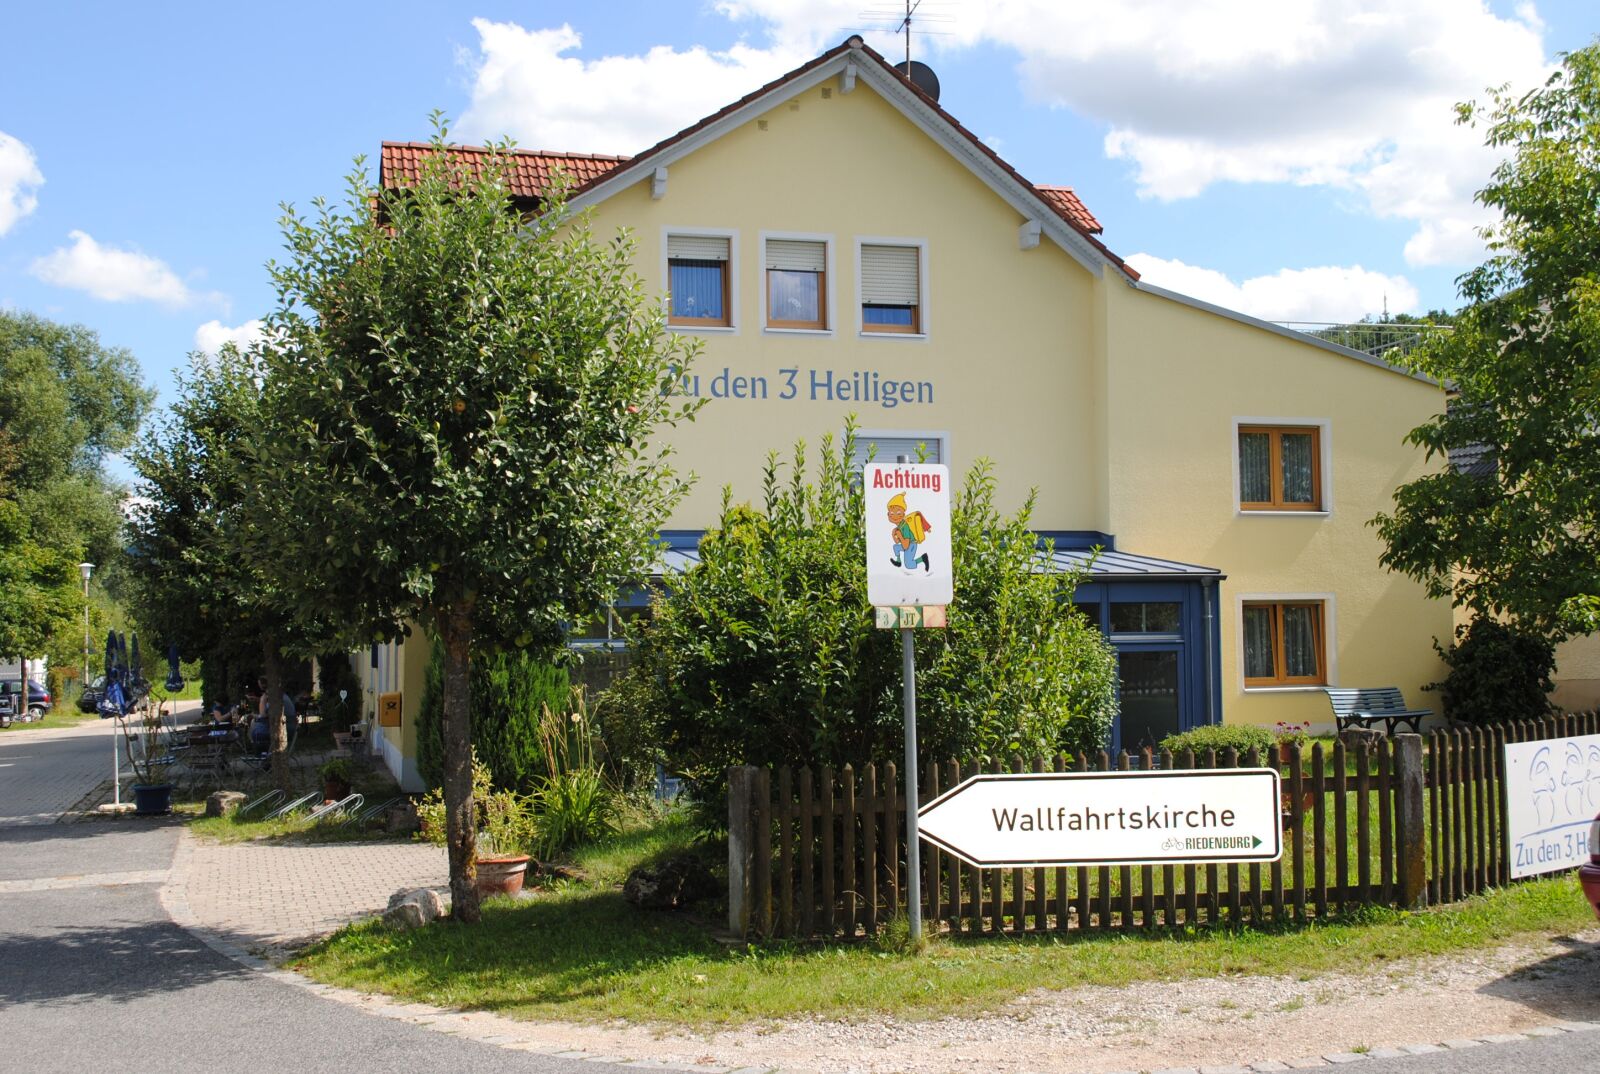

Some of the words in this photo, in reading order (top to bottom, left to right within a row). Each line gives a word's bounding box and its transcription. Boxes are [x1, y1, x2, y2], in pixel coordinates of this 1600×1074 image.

[711, 367, 768, 399] den
[779, 369, 799, 400] 3
[810, 370, 934, 408] Heiligen
[873, 469, 941, 492] Achtung
[992, 804, 1236, 832] Wallfahrtskirche
[1185, 836, 1251, 850] RIEDENBURG
[1515, 843, 1534, 867] Zu
[1537, 839, 1561, 863] den
[1564, 834, 1573, 858] 3
